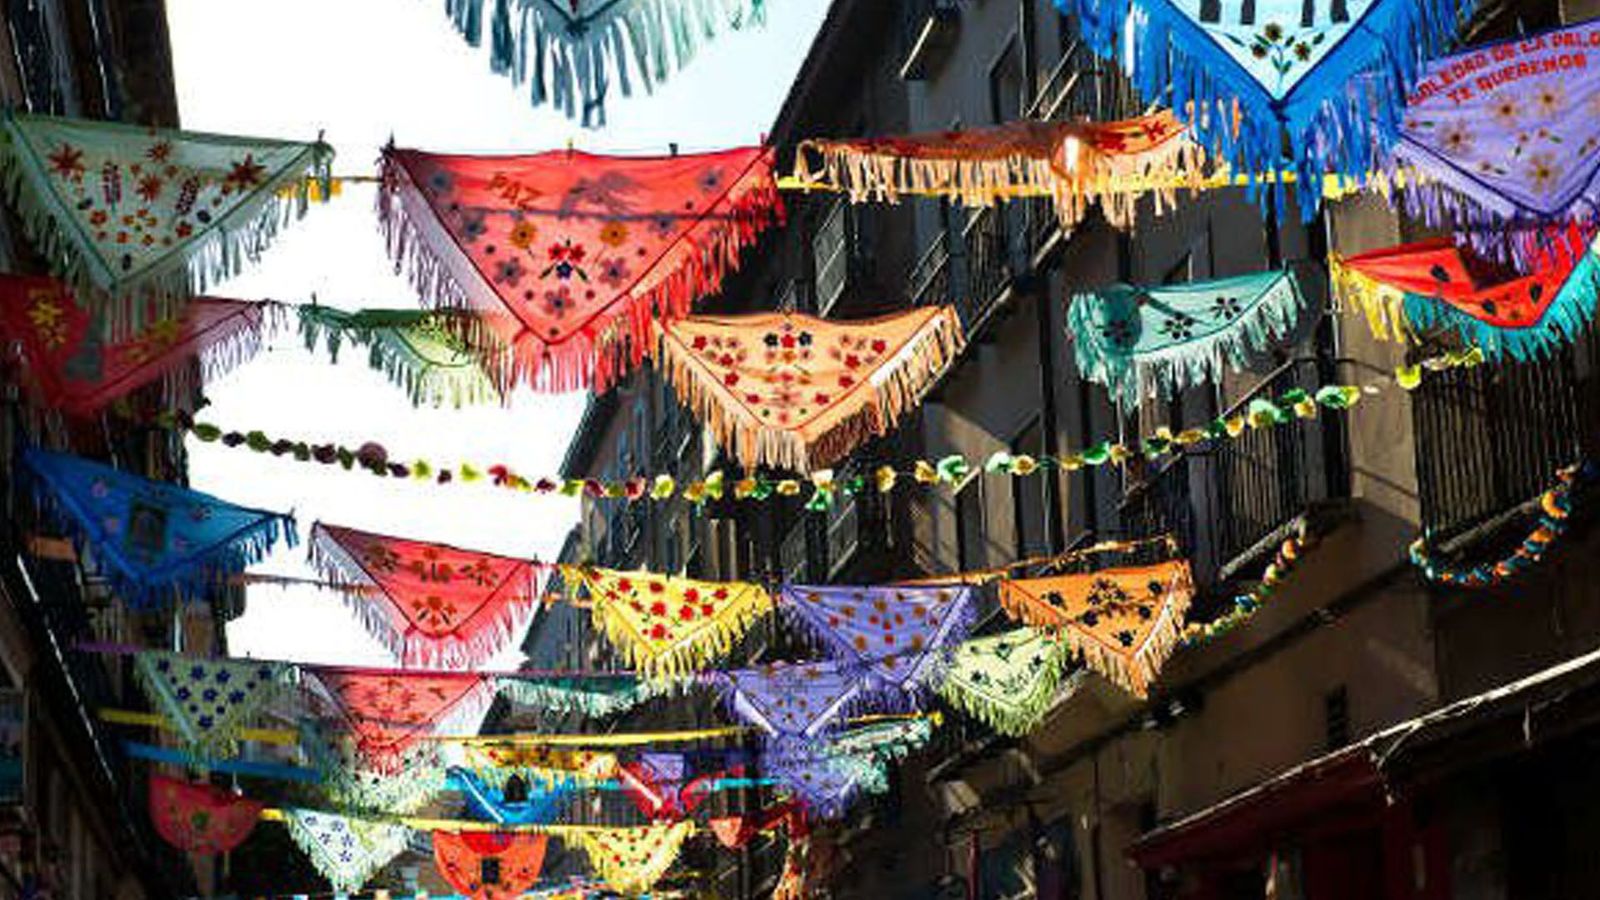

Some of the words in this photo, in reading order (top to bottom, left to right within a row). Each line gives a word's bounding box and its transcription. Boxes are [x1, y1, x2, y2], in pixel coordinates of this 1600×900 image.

[1491, 42, 1515, 62] DE
[1520, 34, 1545, 53] LA
[1447, 86, 1473, 104] TE
[1475, 53, 1587, 92] QUEREMOS
[484, 171, 542, 210] PAZ
